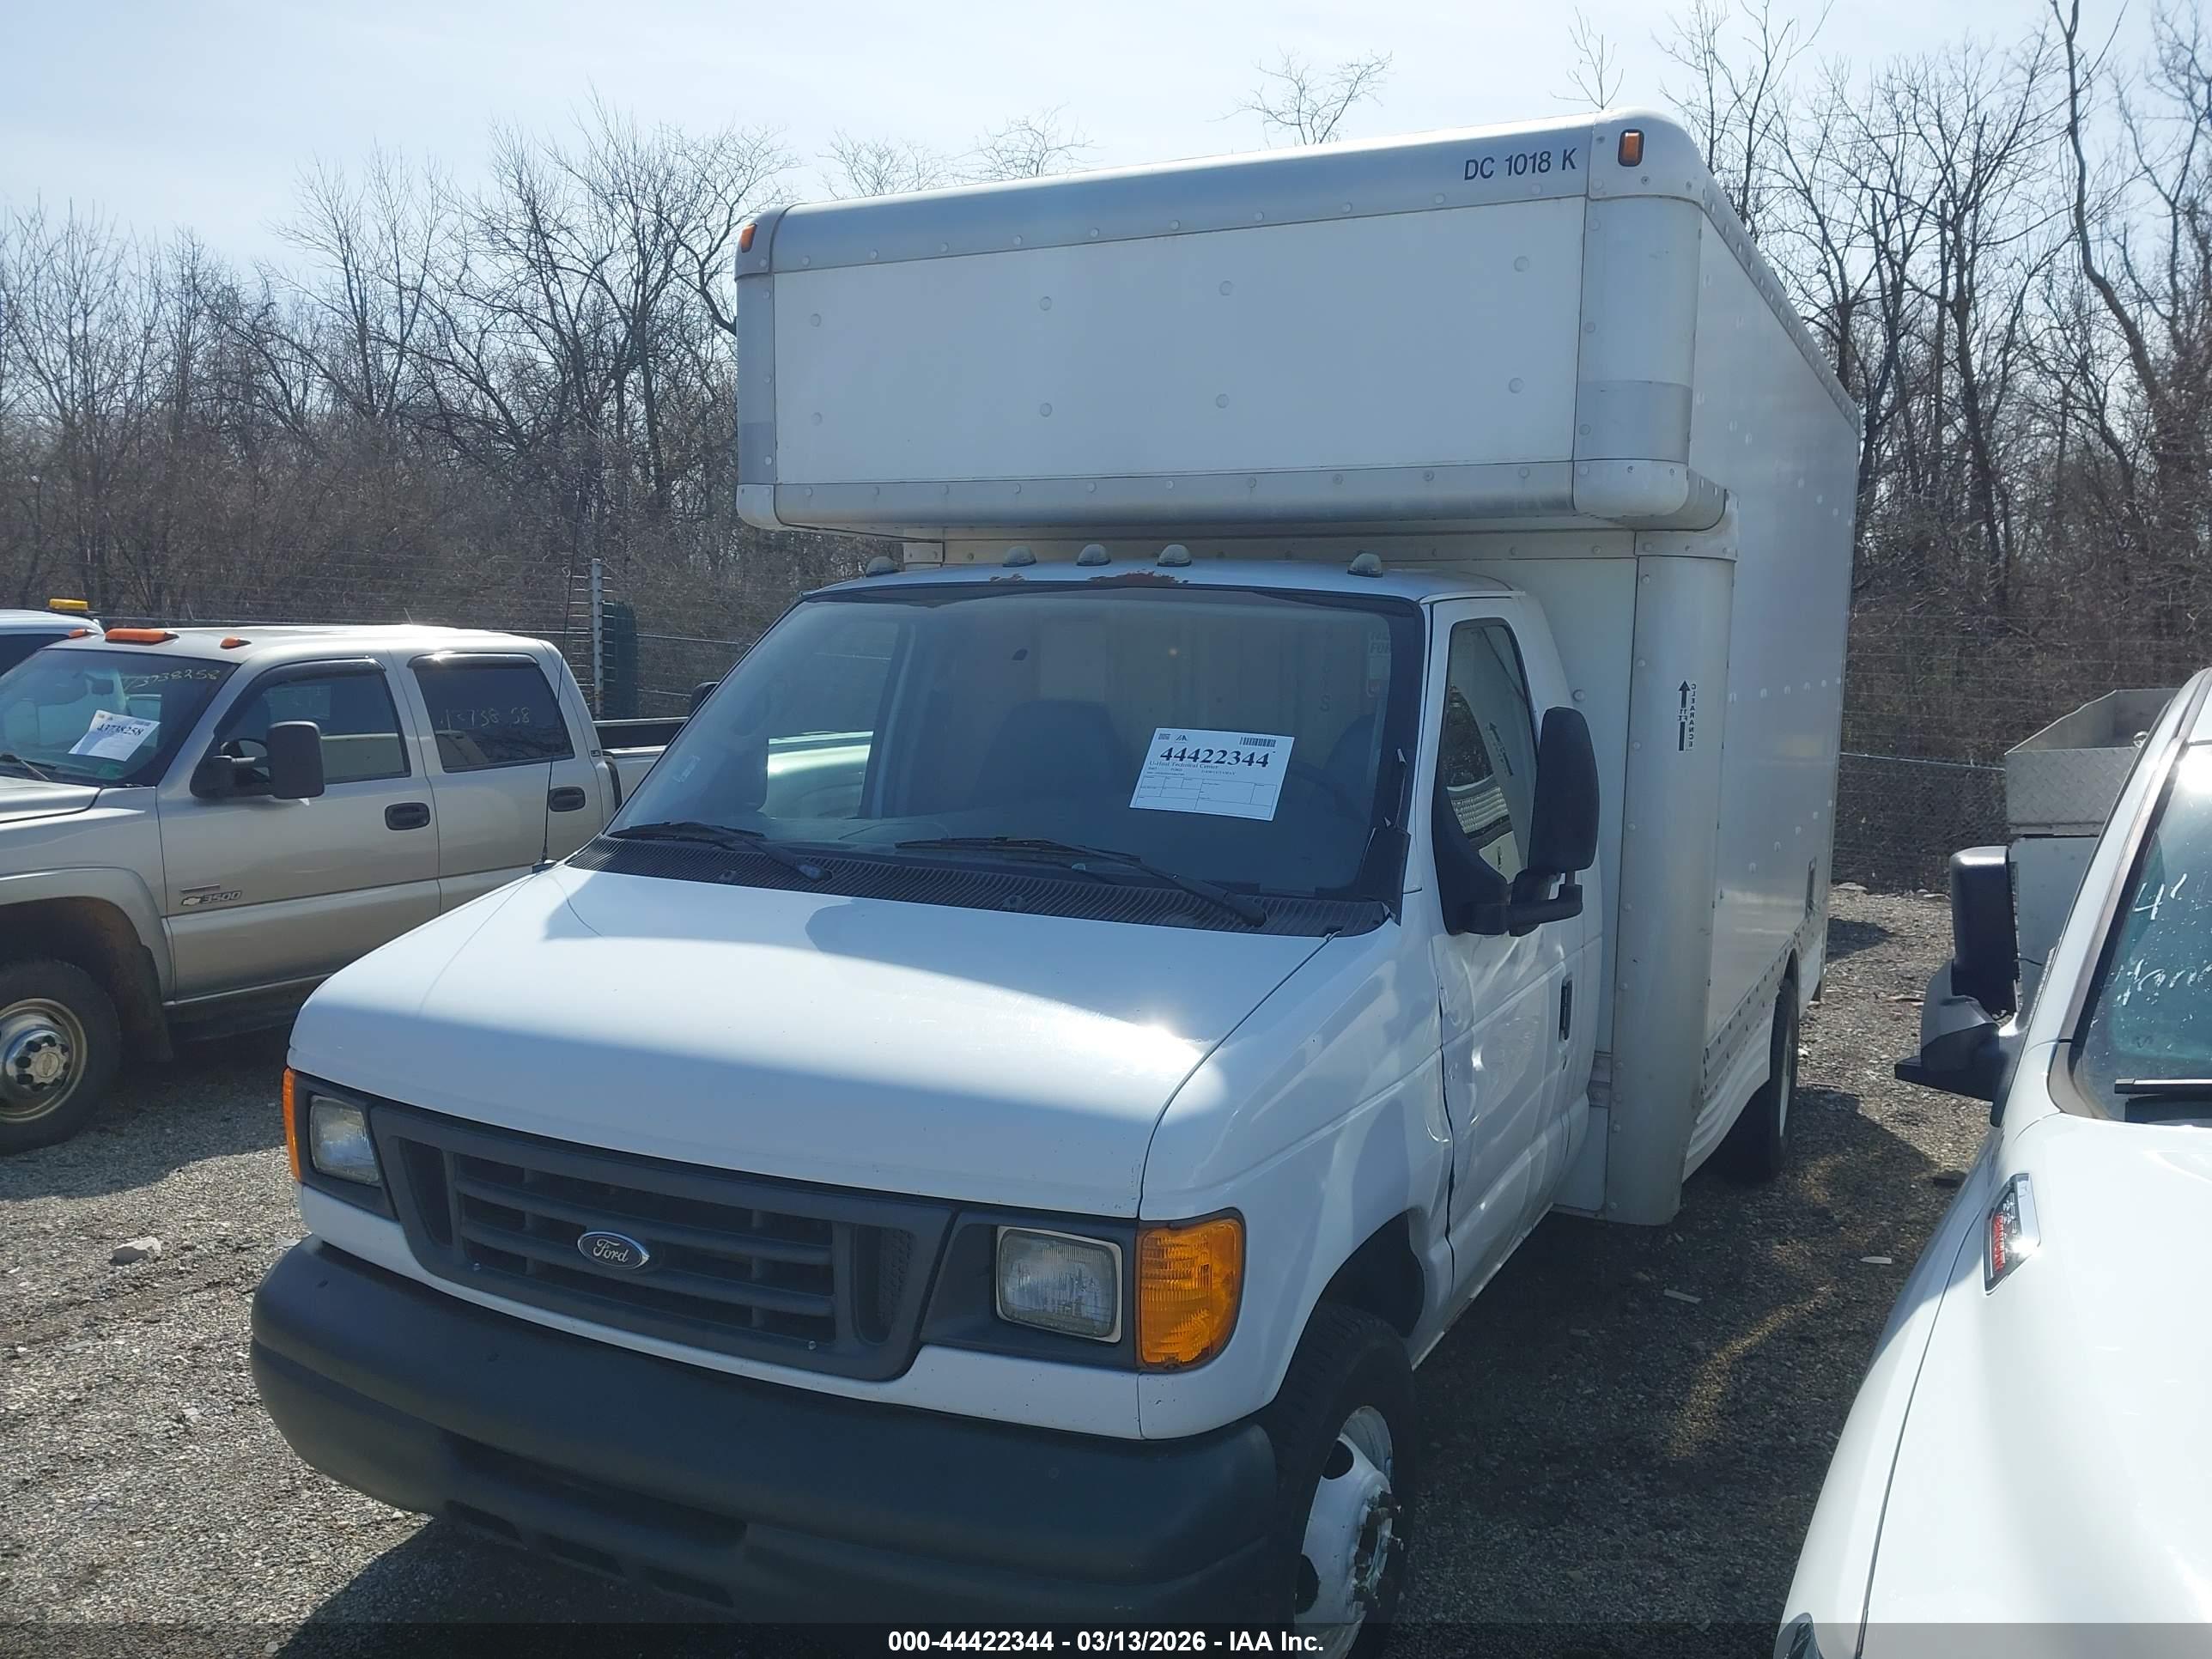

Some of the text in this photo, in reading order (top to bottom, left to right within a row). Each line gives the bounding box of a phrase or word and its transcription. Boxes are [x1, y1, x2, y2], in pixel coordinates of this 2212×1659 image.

[1464, 148, 1577, 180] DC 1018 K
[1160, 747, 1269, 768] 44422344
[203, 891, 241, 903] 3500
[592, 1238, 629, 1262] Ford
